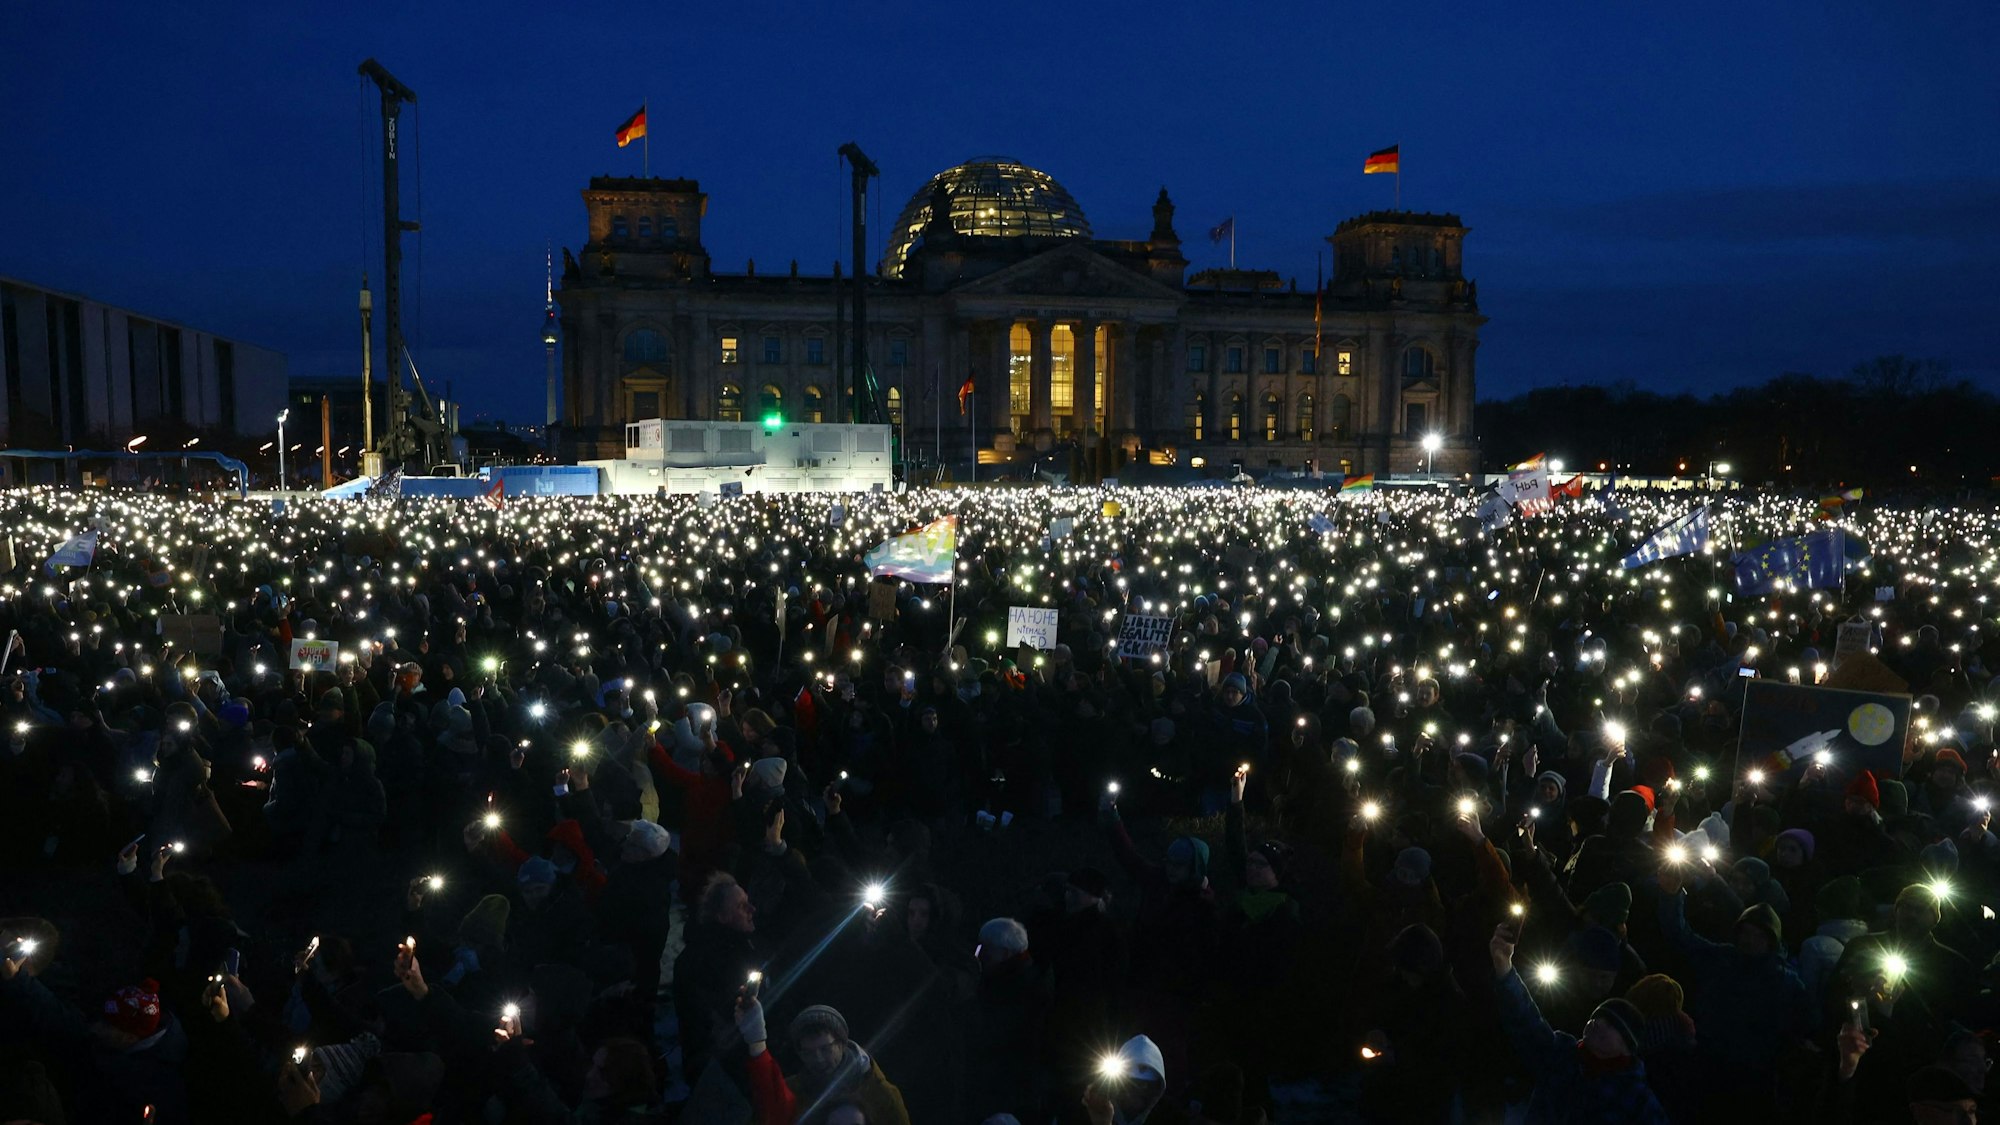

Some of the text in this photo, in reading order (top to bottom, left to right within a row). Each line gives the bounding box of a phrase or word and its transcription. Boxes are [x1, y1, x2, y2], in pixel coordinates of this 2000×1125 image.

[1016, 625, 1047, 636] NIEMALS
[1018, 635, 1047, 648] AFD
[300, 646, 327, 656] STOPPT
[306, 655, 323, 664] AFD
